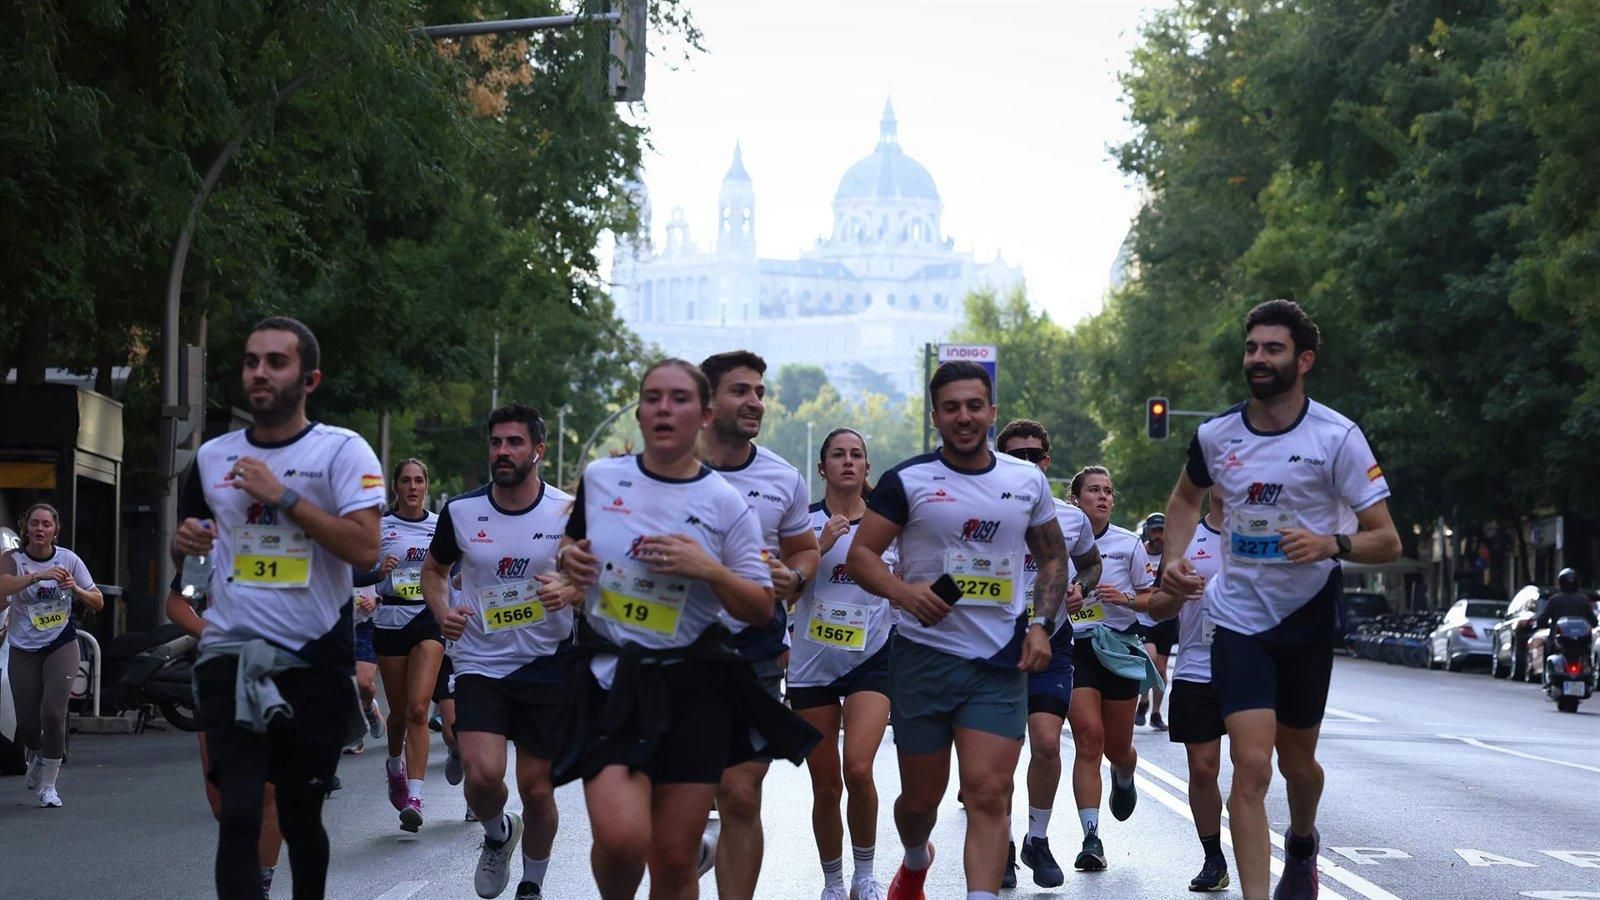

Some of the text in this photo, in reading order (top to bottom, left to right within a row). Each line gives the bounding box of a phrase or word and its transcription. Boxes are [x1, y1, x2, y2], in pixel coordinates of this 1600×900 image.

[1238, 540, 1279, 554] 2277
[254, 560, 277, 577] 31
[956, 580, 1001, 597] 2276
[39, 614, 61, 625] 3340
[493, 606, 533, 624] 1566
[623, 602, 648, 621] 19
[1071, 609, 1095, 621] 382
[815, 625, 854, 642] 1567
